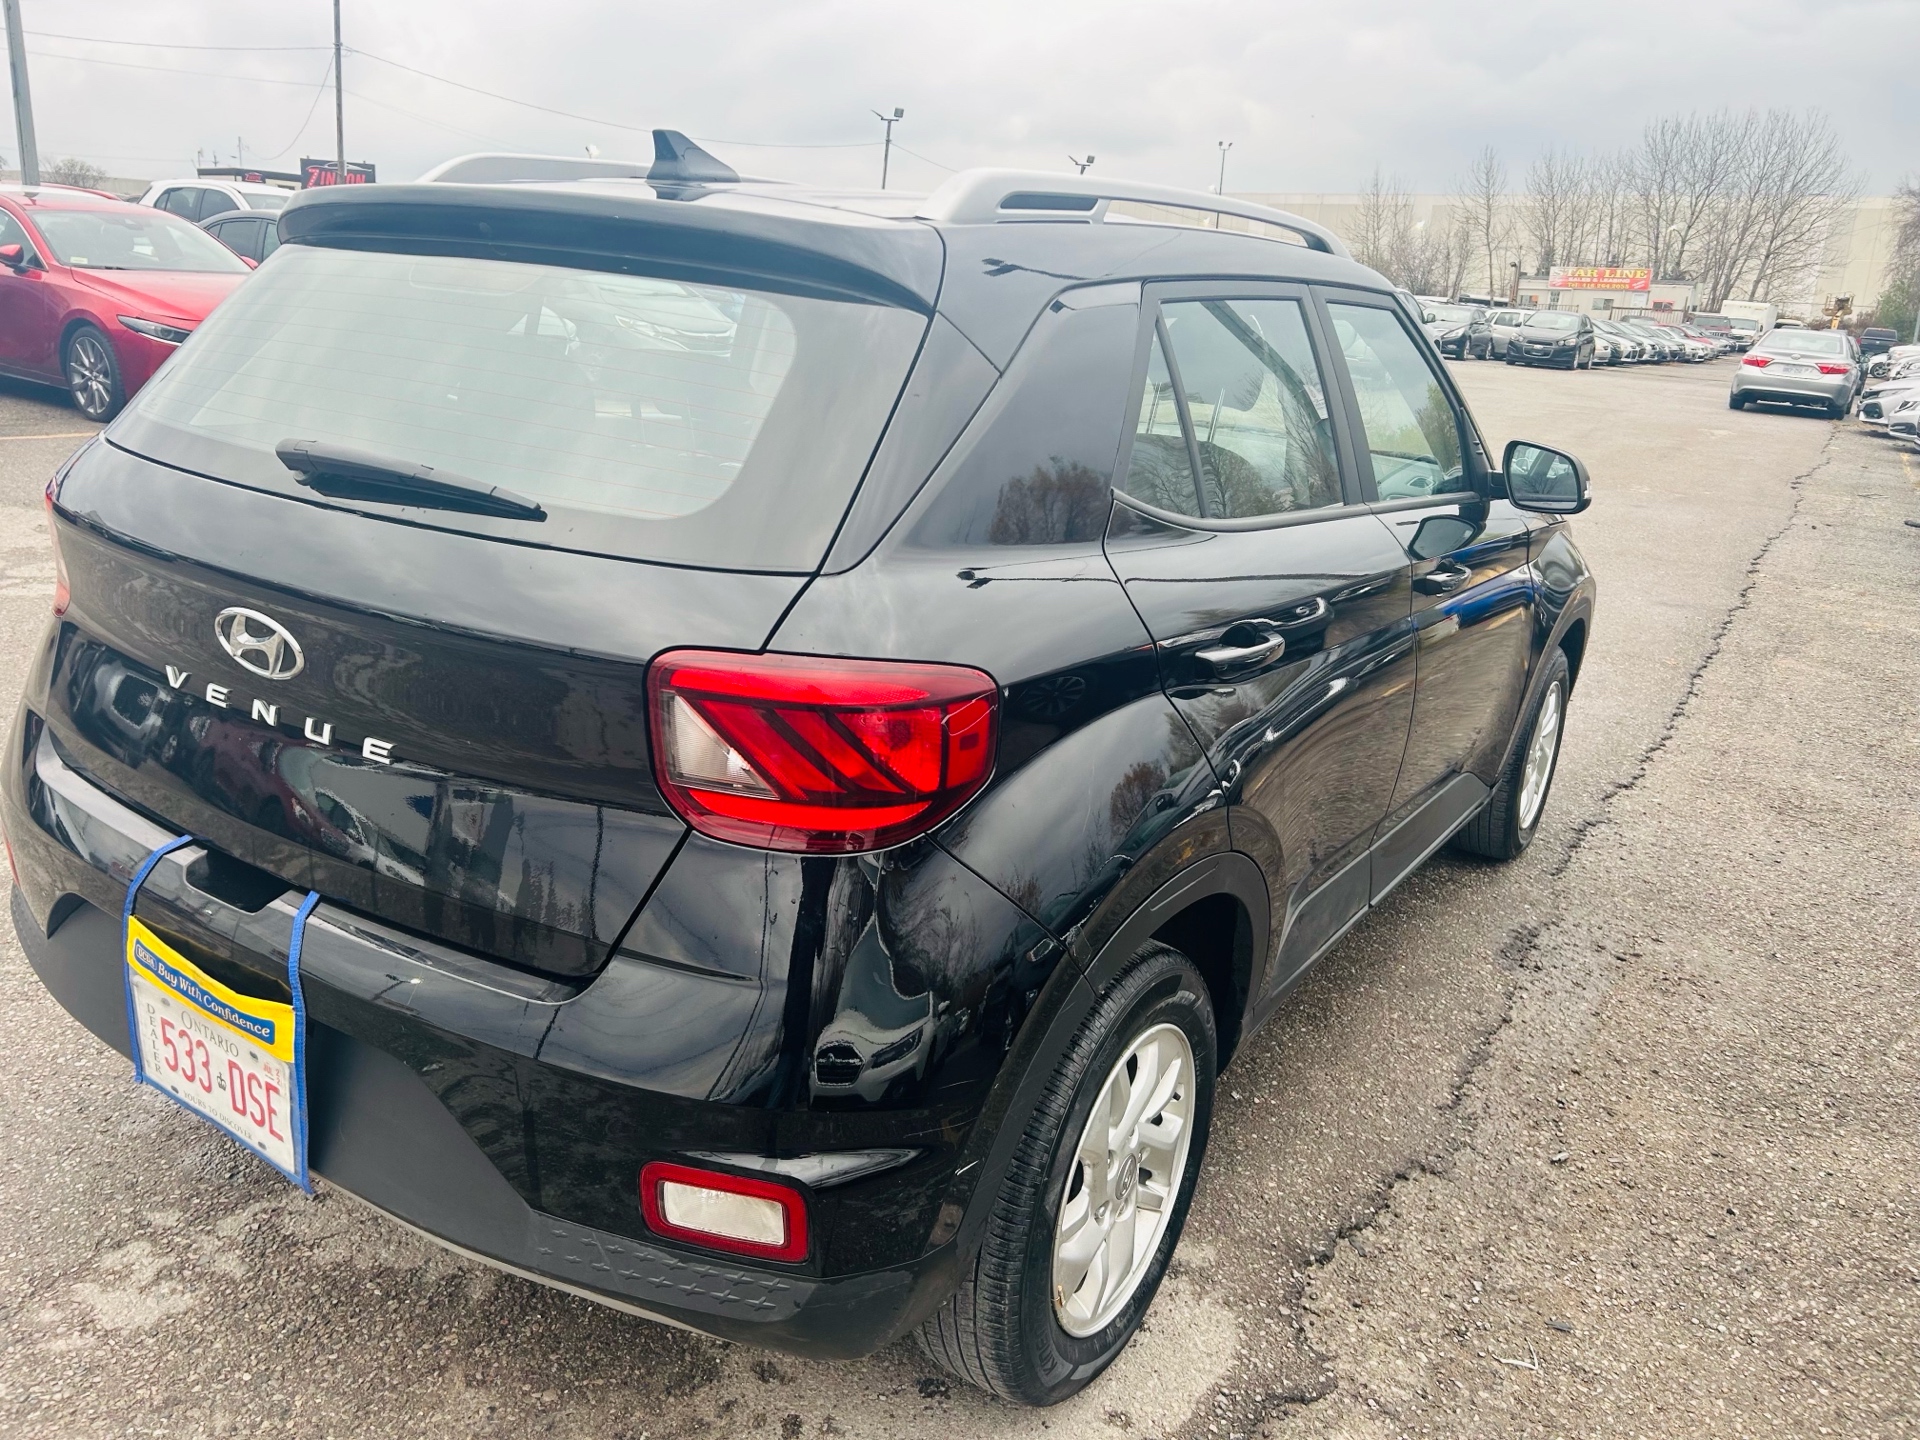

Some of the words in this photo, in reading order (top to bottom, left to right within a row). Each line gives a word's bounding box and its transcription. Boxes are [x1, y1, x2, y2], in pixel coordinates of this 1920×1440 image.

[307, 167, 366, 188] ZINON
[1553, 268, 1598, 277] STAR
[1604, 268, 1648, 279] LINE
[165, 664, 398, 766] VENUE
[158, 963, 178, 987] Buy
[179, 976, 203, 1003] With
[203, 994, 271, 1038] Confidence
[146, 1002, 163, 1075] DEALER
[181, 1010, 240, 1058] ONTARIO
[160, 1016, 213, 1094] 533
[227, 1058, 285, 1143] DSE
[183, 1090, 206, 1111] YOURS
[208, 1105, 218, 1117] TO
